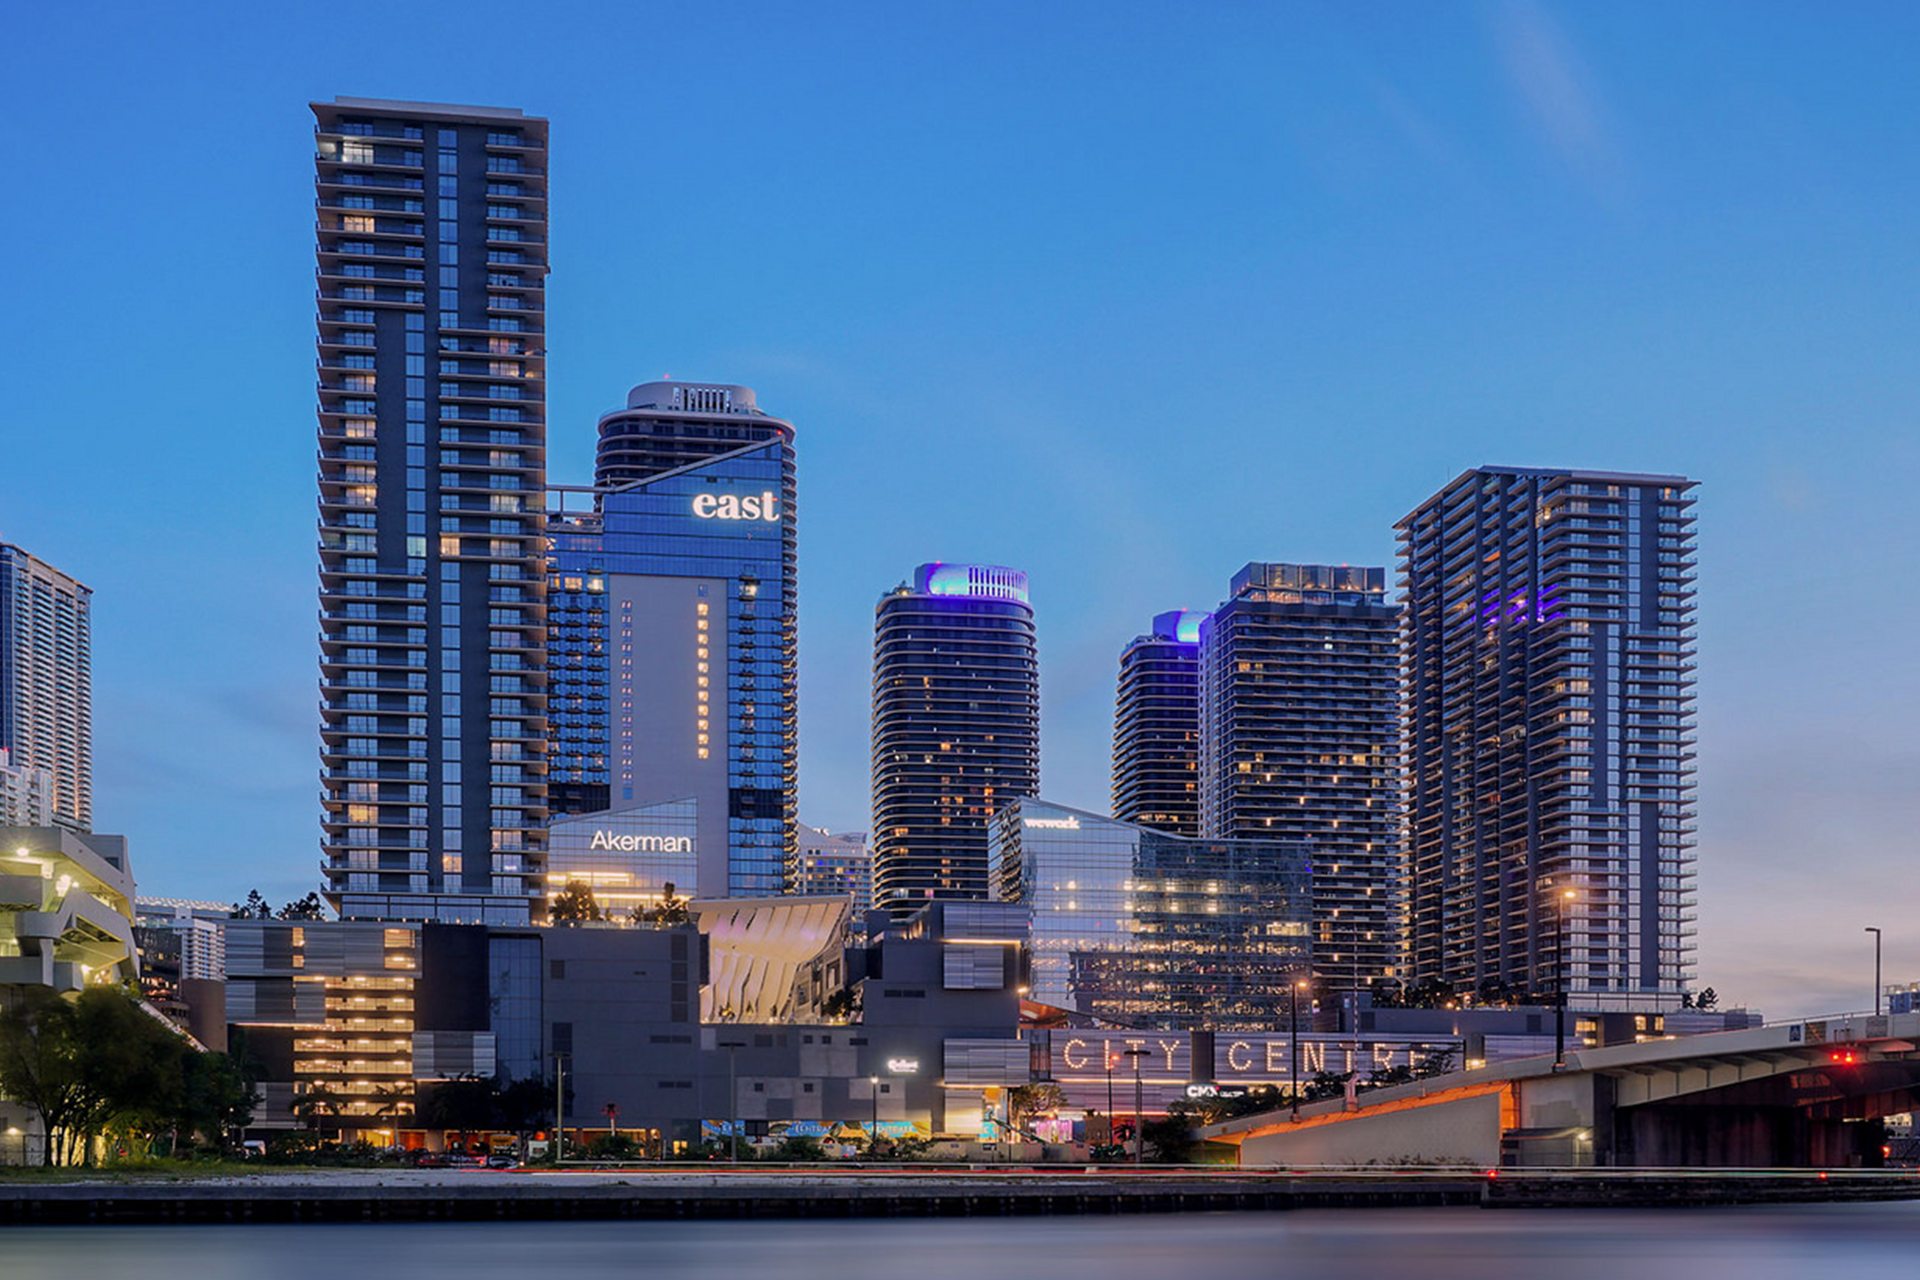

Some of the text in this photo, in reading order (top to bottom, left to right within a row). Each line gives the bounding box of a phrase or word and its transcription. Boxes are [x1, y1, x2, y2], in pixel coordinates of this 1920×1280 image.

[692, 491, 780, 521] east
[590, 829, 691, 852] Akerman
[1063, 1038, 1430, 1073] CITY CENTRE
